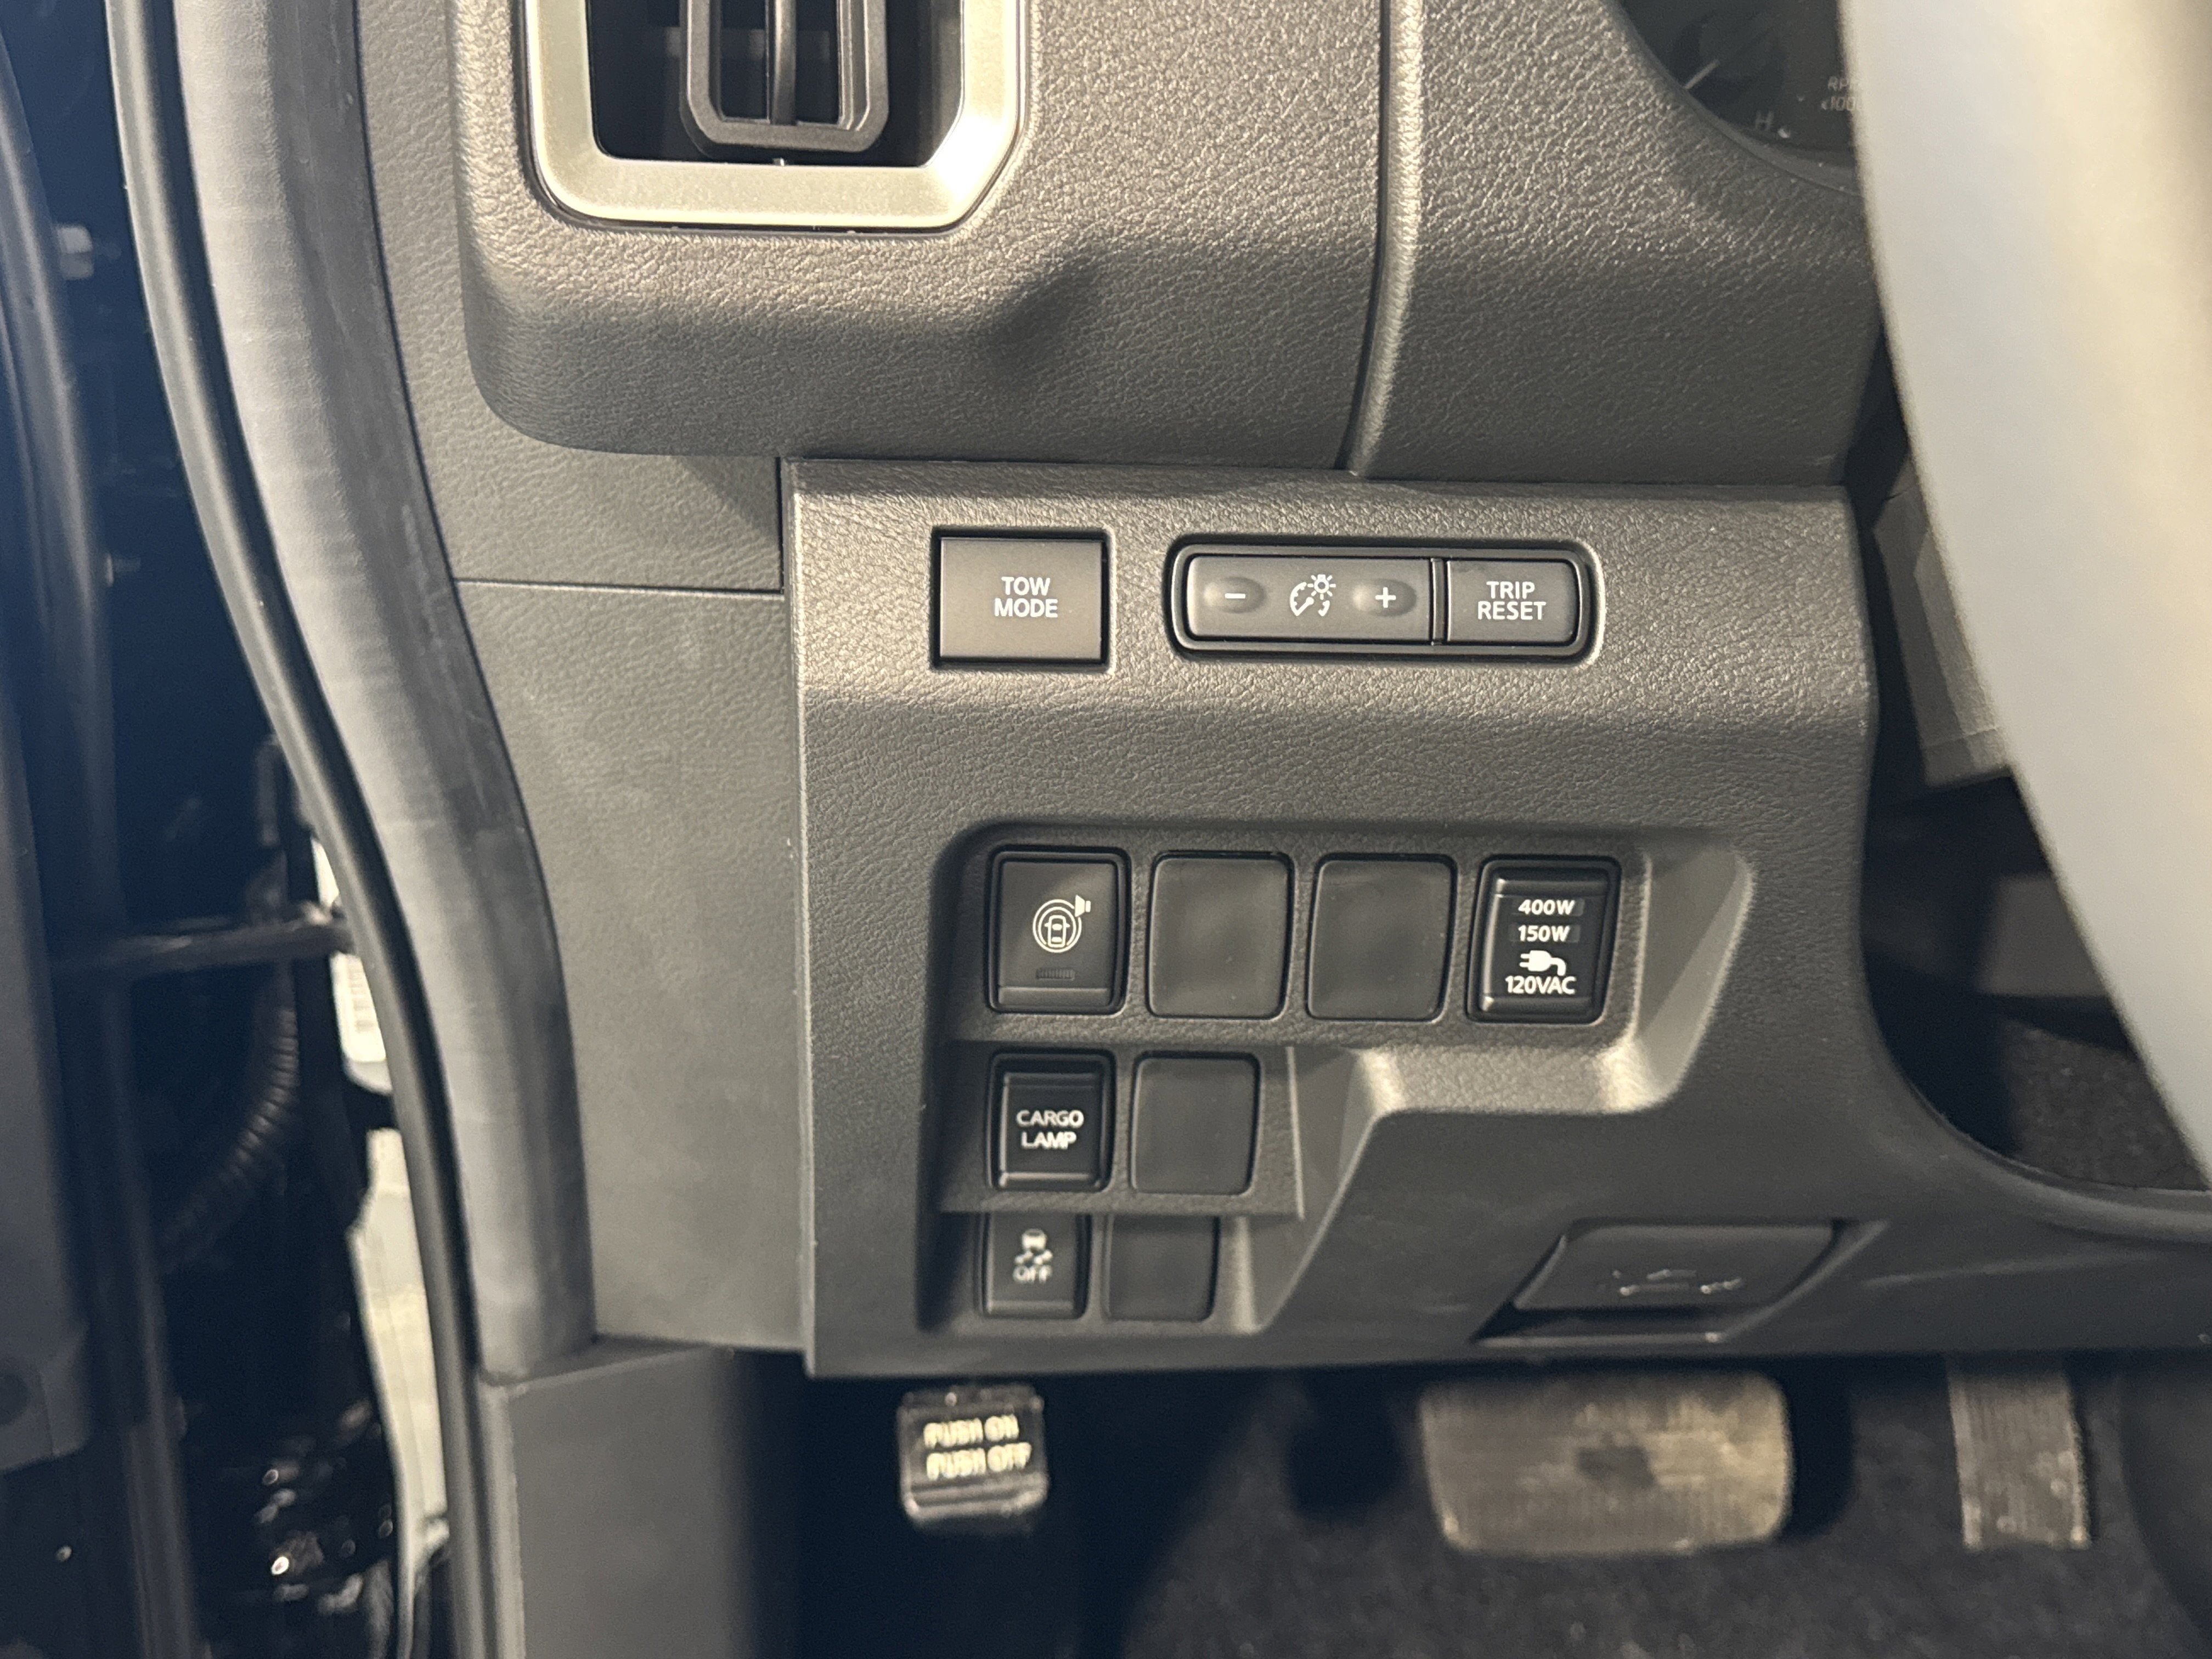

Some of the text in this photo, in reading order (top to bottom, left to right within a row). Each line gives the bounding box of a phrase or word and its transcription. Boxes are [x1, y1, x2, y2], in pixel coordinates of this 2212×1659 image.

[1001, 576, 1051, 596] TOW
[1486, 580, 1535, 600] TRIP
[994, 597, 1058, 618] MODE
[1477, 601, 1547, 620] RESET
[1517, 899, 1575, 916] 400W
[1517, 924, 1571, 943] 150W
[1504, 975, 1577, 995] 120VAC
[1016, 1109, 1085, 1129] CARGO
[1021, 1131, 1077, 1150] LAMP
[1012, 1265, 1053, 1284] OFF
[923, 1414, 1019, 1449] PUSH ON
